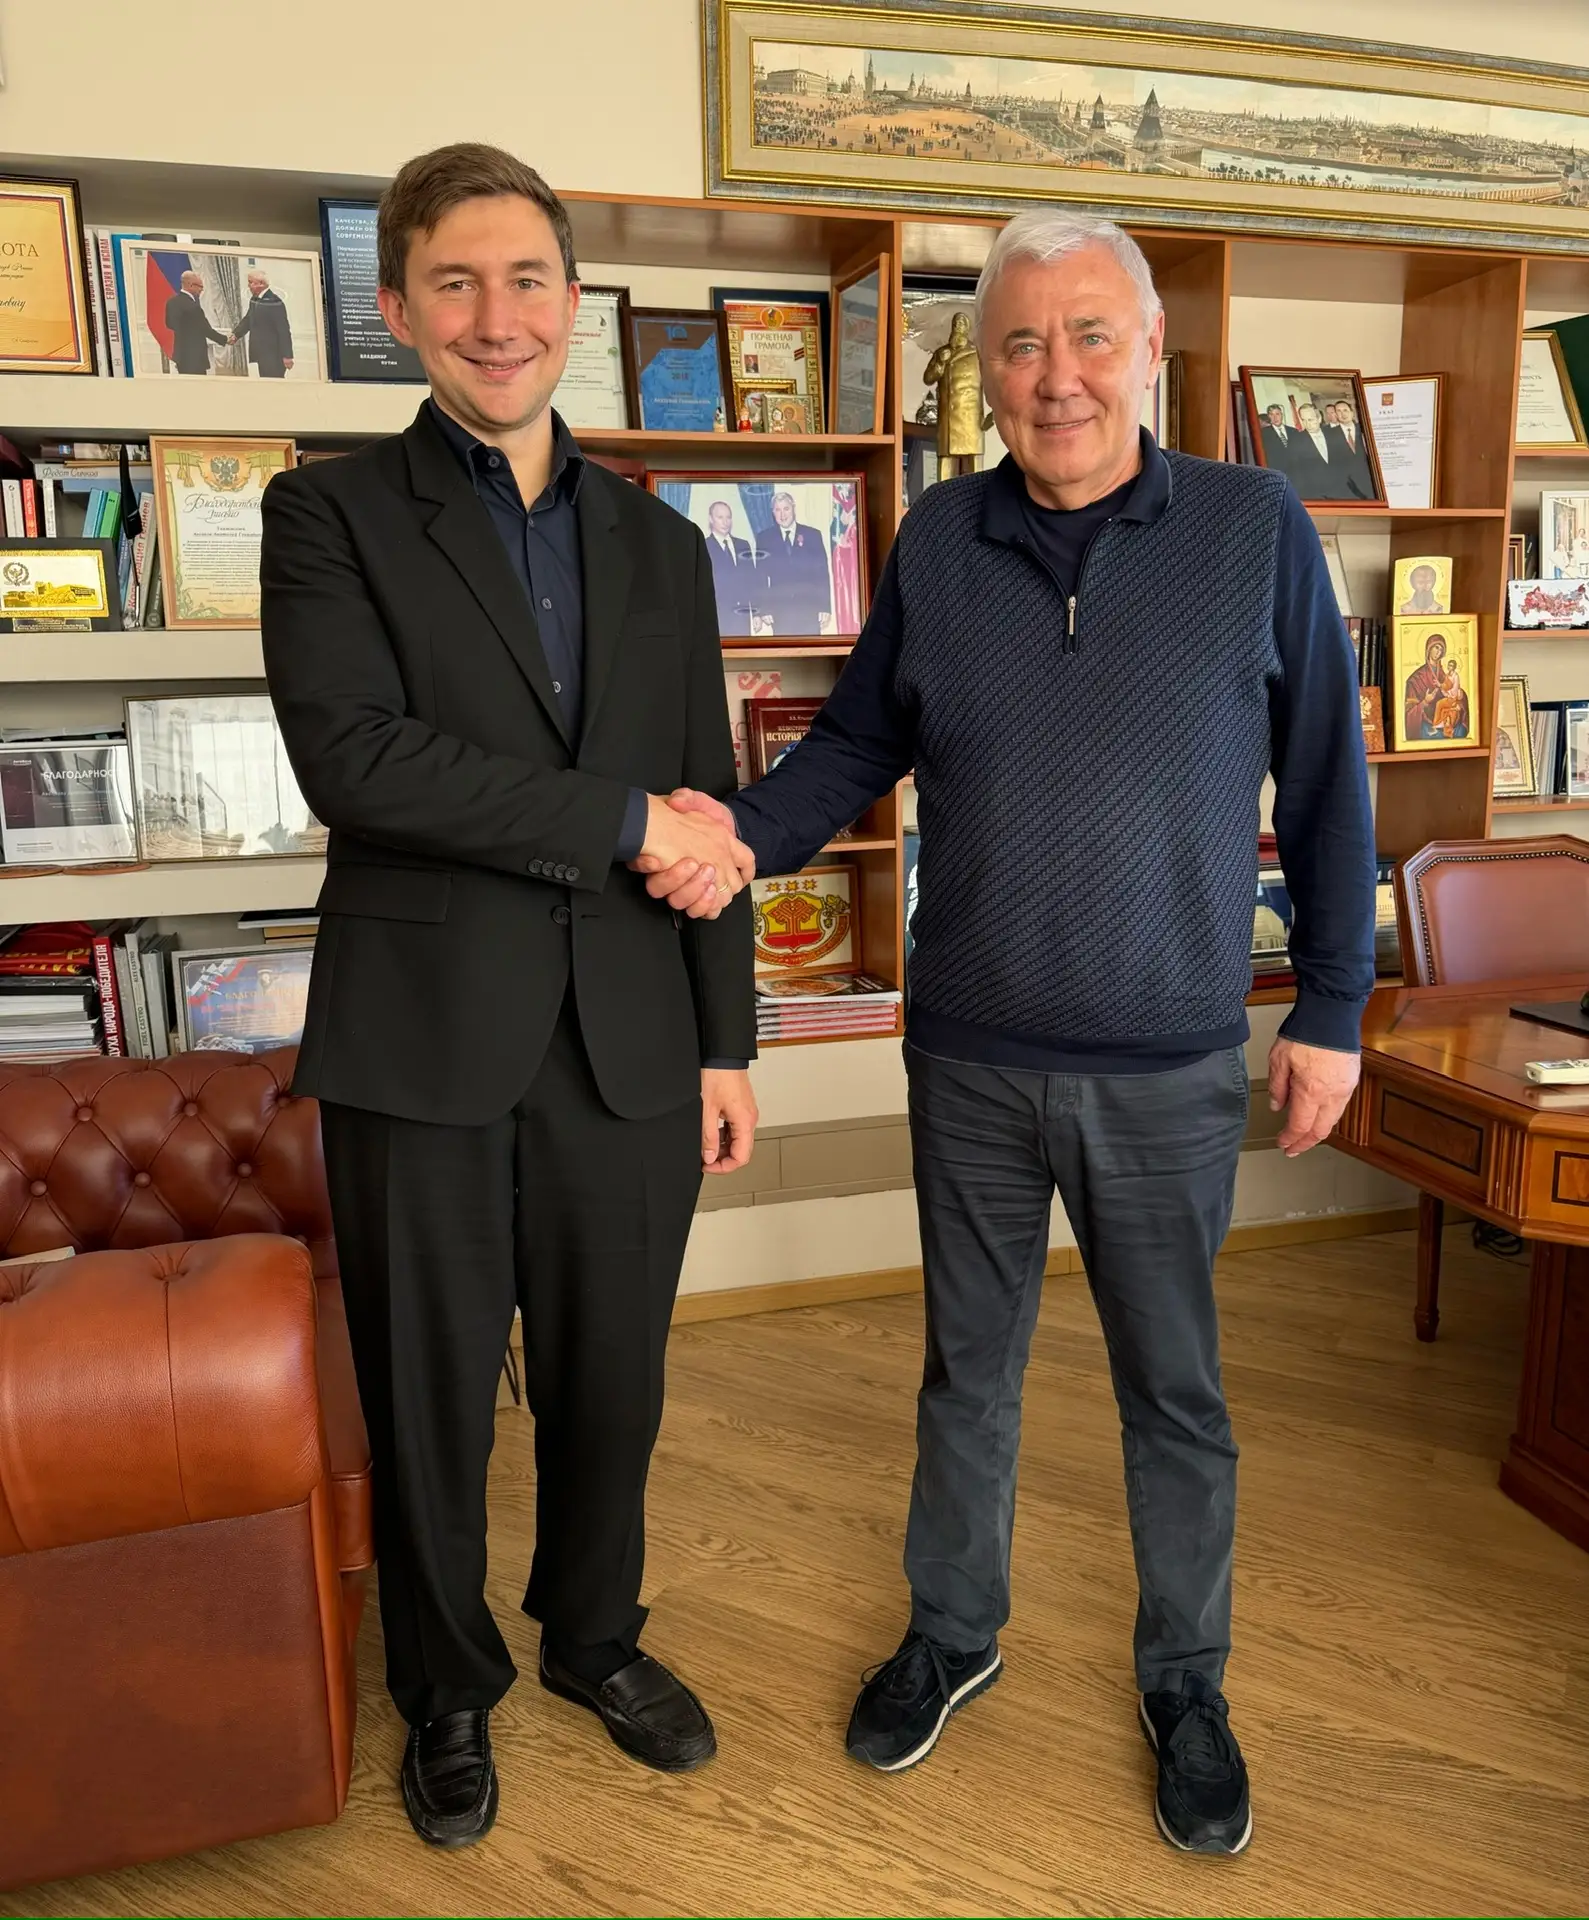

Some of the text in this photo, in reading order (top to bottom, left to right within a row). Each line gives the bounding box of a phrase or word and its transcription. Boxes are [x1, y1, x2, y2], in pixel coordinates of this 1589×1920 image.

[0, 242, 40, 258] ОТА
[100, 238, 110, 262] ИСЛАМ
[104, 271, 115, 300] ЕВРАЗИЯ
[750, 332, 793, 341] ПОЧЕТНАЯ
[42, 467, 70, 478] Федот
[766, 732, 802, 742] ИСТОРИЯ
[43, 769, 114, 780] БЛАГОДАРНОС
[96, 944, 120, 1057] ДУХА НАРОДА-ПОБЕДИТЕЛЯ
[137, 1007, 146, 1030] CASTRO
